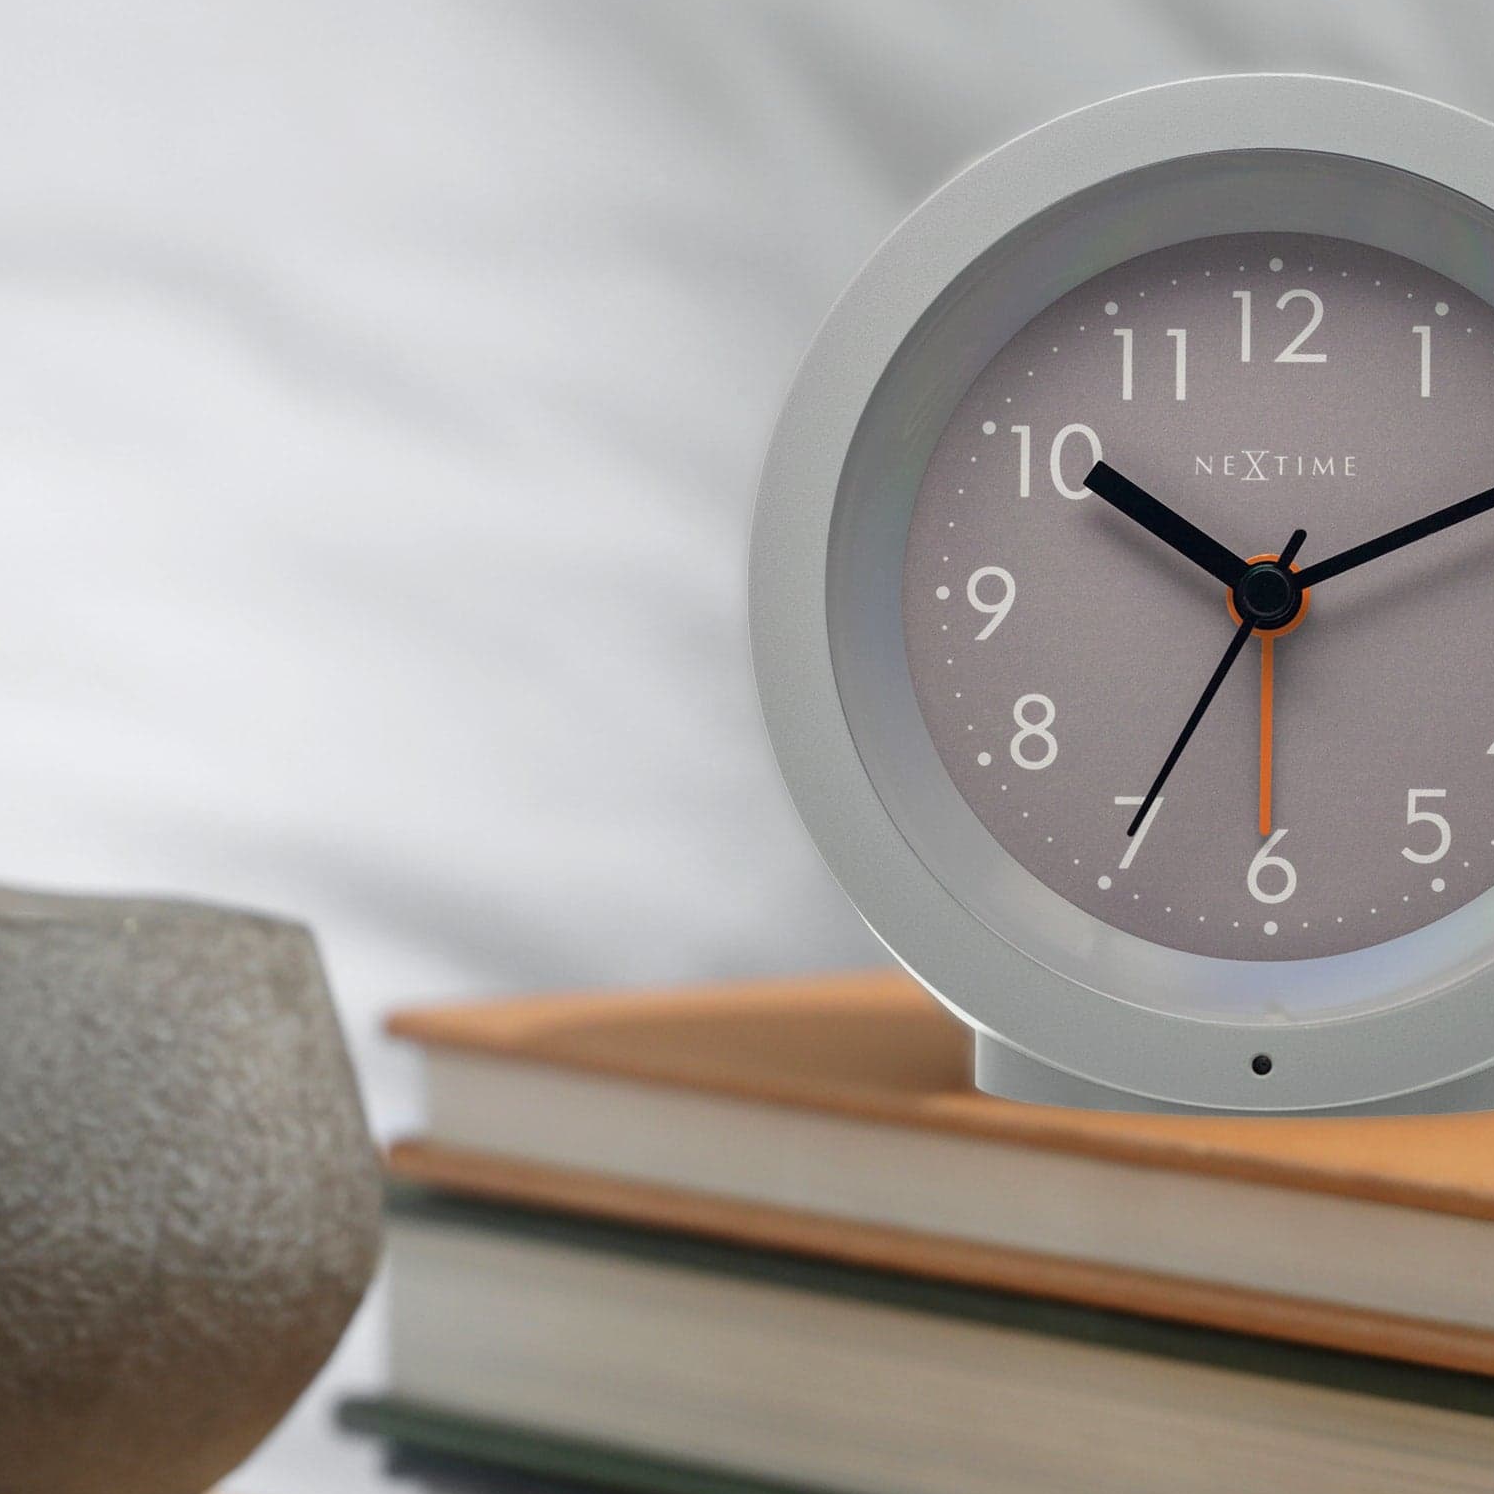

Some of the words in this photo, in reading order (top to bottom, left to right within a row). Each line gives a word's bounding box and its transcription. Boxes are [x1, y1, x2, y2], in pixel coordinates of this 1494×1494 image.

[1233, 289, 1328, 363] 12
[1412, 326, 1431, 398] 1
[1113, 328, 1187, 401] 11
[1010, 423, 1103, 501] 10
[1196, 450, 1356, 481] NEXTIME
[966, 566, 1016, 641] 9
[1010, 693, 1058, 770] 8
[1114, 795, 1165, 869] 7
[1401, 788, 1452, 864] 5
[1247, 828, 1297, 904] 6
